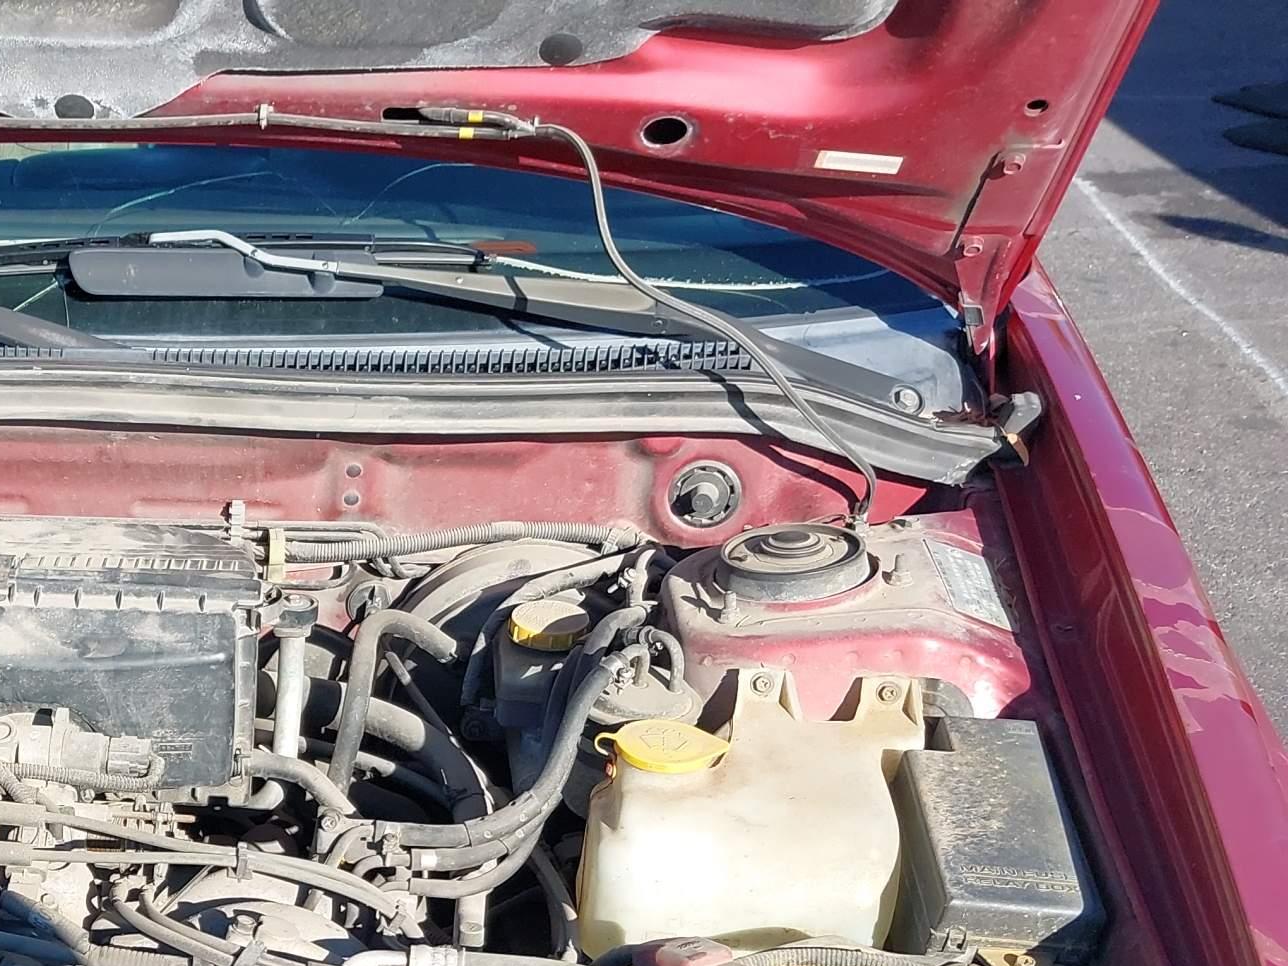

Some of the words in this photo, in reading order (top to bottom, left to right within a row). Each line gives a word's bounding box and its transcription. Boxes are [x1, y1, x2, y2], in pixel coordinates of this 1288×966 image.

[960, 864, 1017, 876] MAIN
[962, 876, 1031, 890] RELAY
[1035, 881, 1080, 894] BOX
